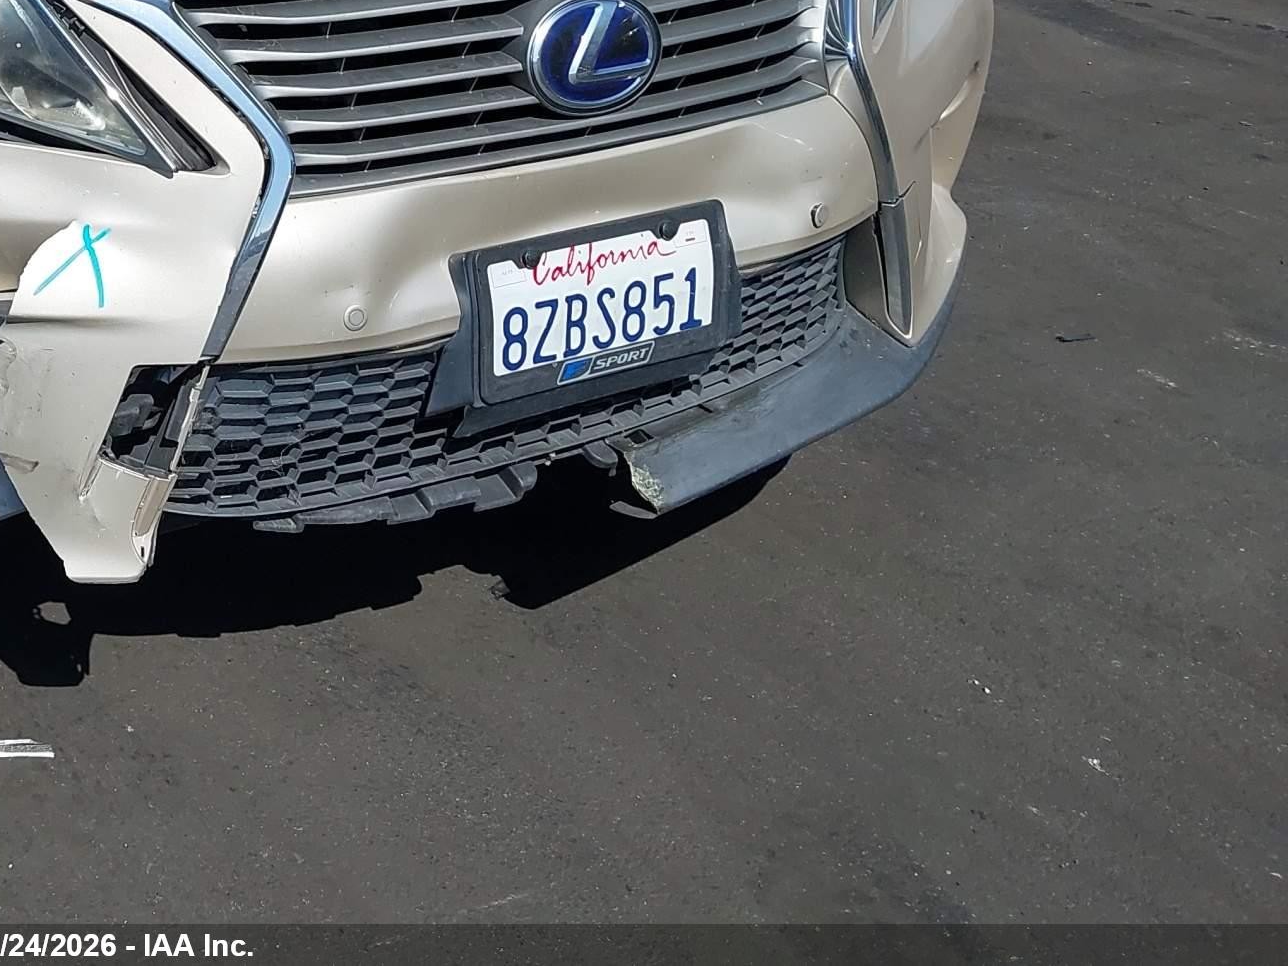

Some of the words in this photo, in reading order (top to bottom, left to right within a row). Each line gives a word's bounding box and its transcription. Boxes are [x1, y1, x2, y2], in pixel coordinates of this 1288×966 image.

[532, 240, 677, 286] California
[501, 266, 703, 372] 8ZBS851
[593, 346, 650, 371] SPORT
